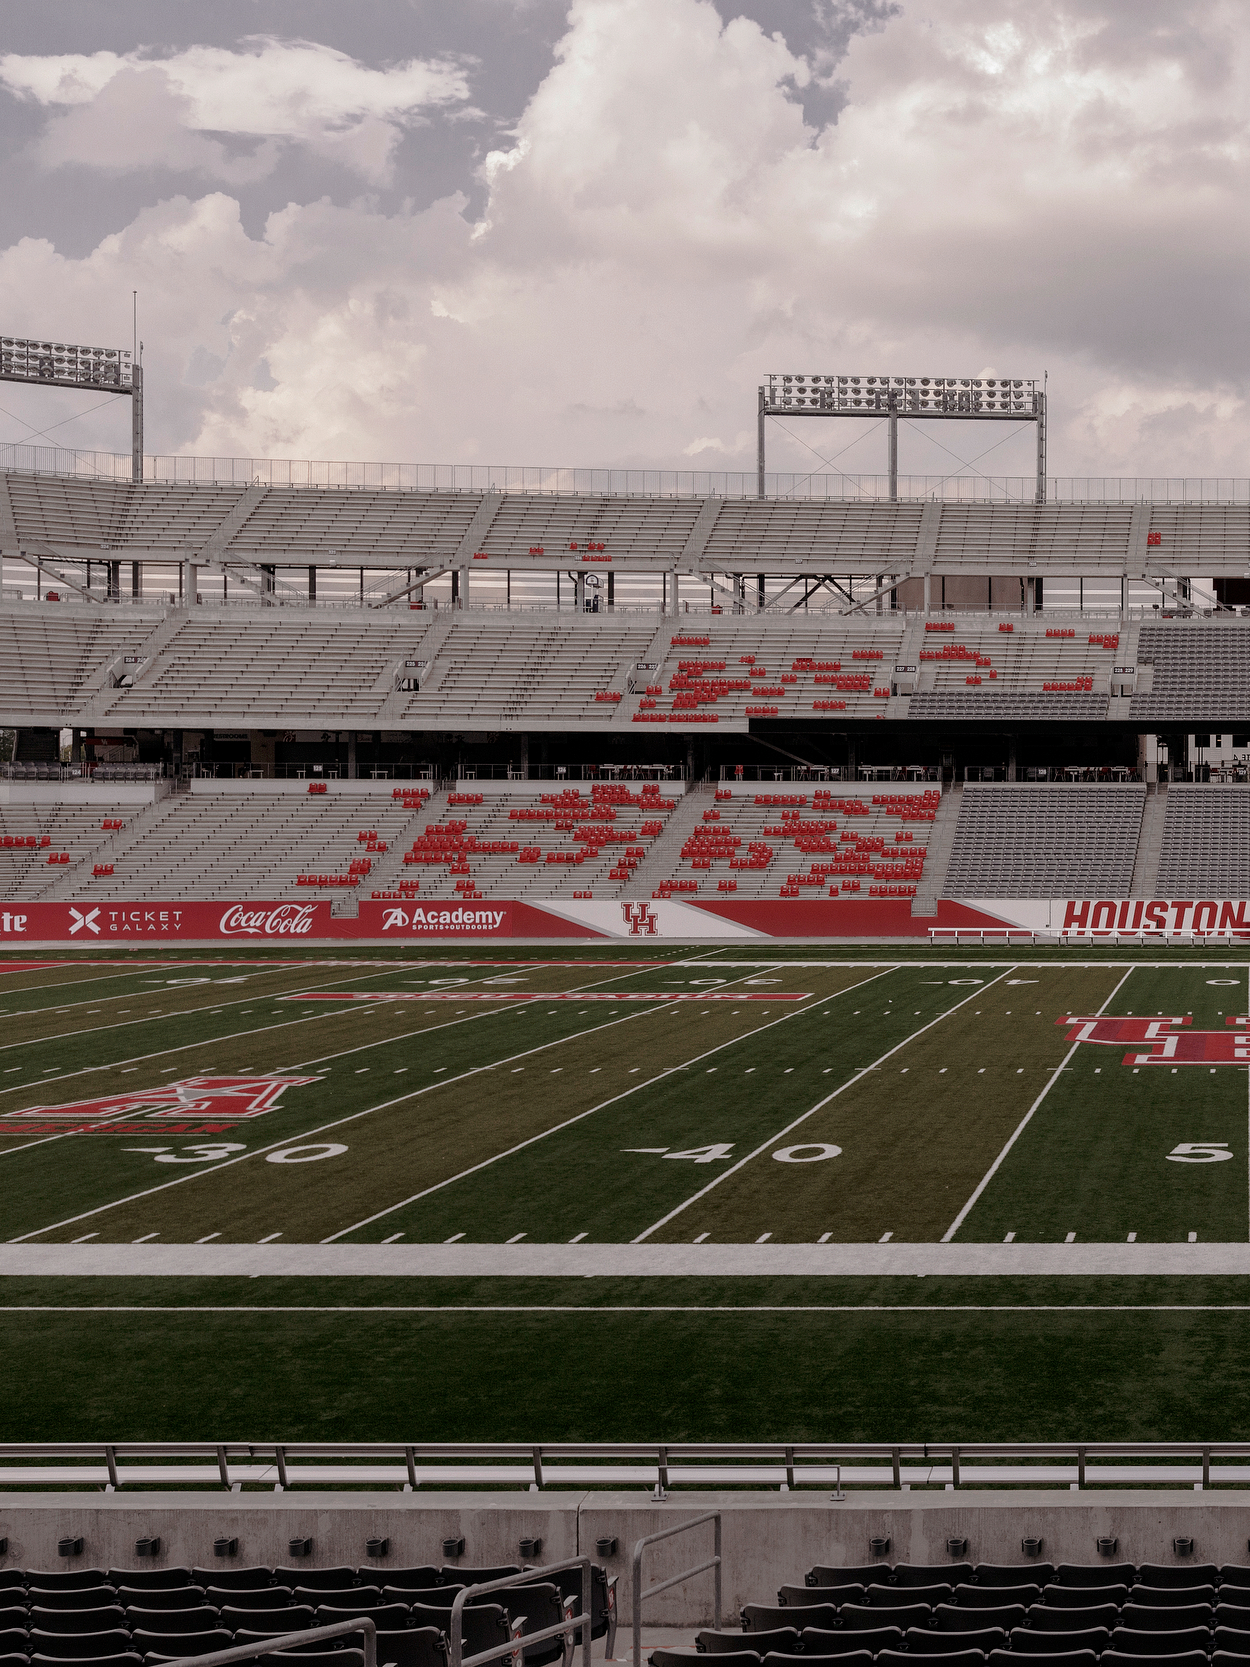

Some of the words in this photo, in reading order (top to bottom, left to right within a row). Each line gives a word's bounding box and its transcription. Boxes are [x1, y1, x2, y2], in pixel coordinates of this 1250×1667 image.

[109, 911, 182, 921] TICKET
[219, 904, 318, 934] Coca-Cola
[412, 907, 503, 928] Academy
[1061, 901, 1249, 936] HOUSTON
[109, 923, 182, 931] GALAXY
